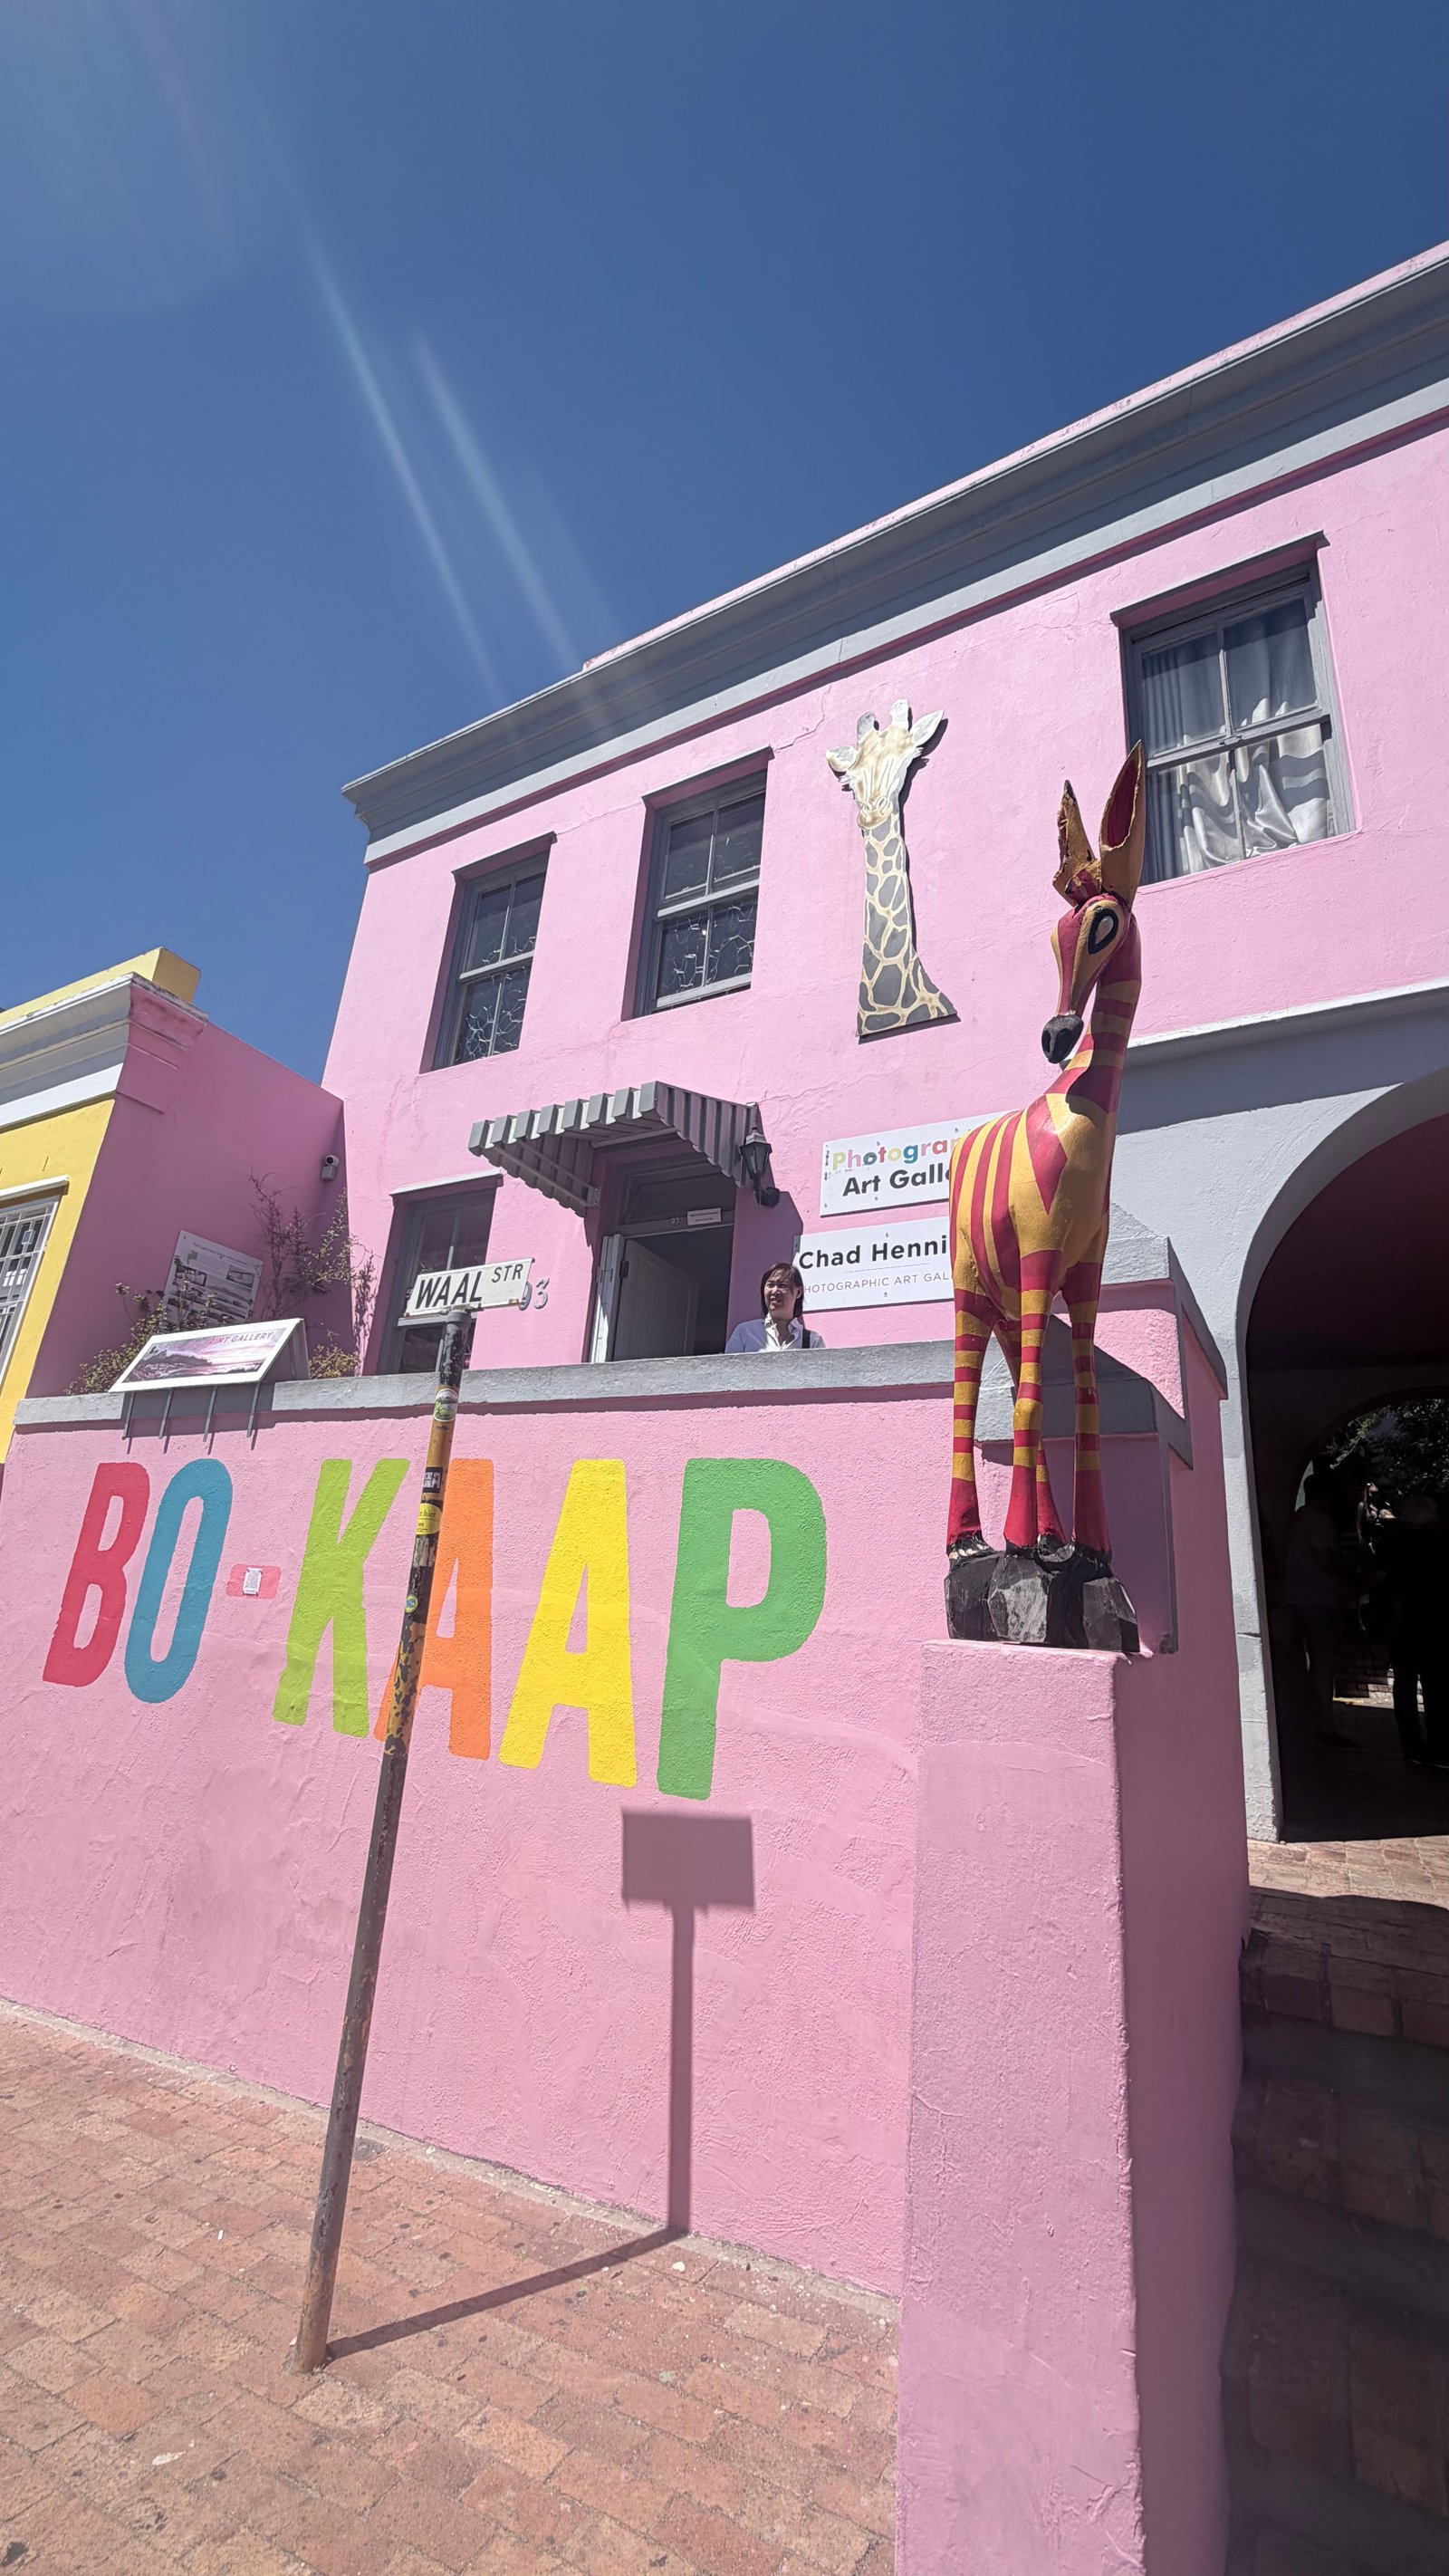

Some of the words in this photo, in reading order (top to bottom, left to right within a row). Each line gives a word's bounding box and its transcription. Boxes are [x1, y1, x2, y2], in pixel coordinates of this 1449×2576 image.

[842, 1175, 881, 1197] Art
[799, 1245, 860, 1269] Chad
[872, 1235, 947, 1262] Henni
[415, 1271, 483, 1310] WAAL
[492, 1264, 523, 1283] STR
[804, 1277, 889, 1293] HOTOGRAPHIC
[894, 1274, 918, 1285] ART
[924, 1272, 950, 1282] GAL
[231, 1331, 274, 1342] GALLERY
